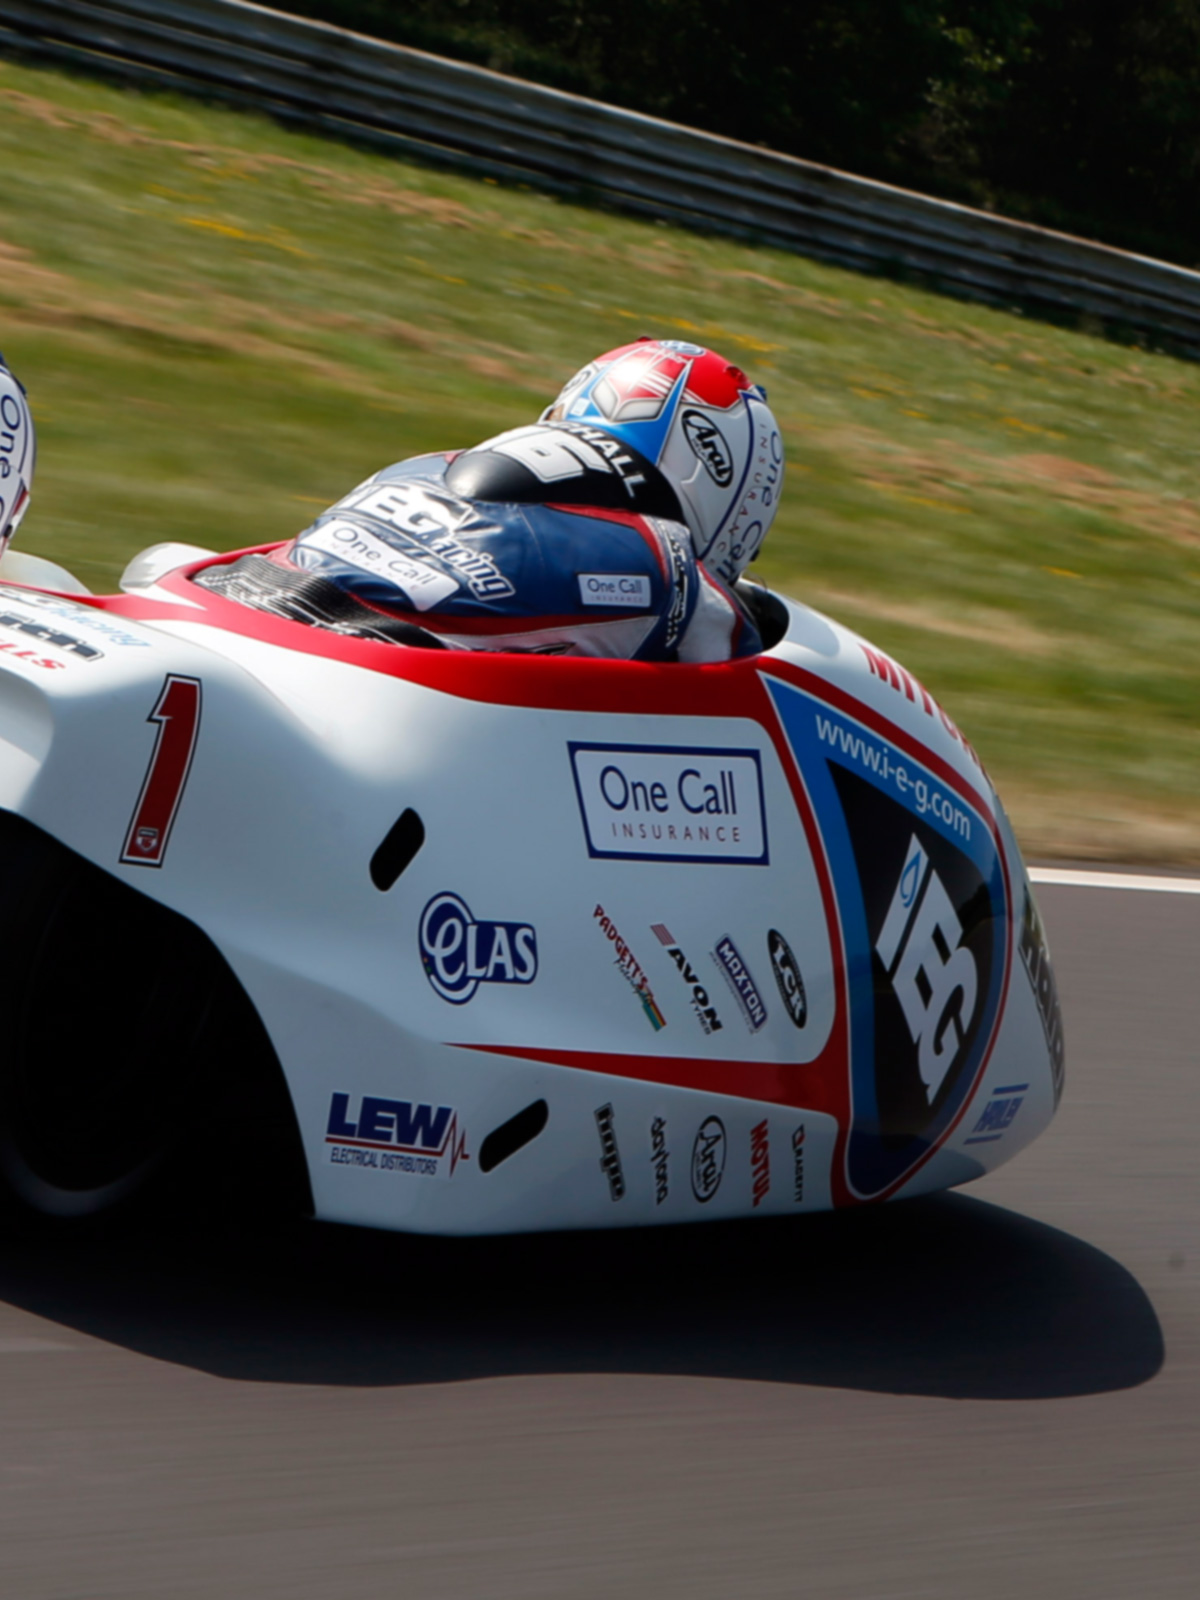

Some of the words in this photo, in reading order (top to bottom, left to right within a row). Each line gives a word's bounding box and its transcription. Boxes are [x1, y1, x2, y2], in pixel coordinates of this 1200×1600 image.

[683, 411, 732, 480] Arai
[762, 431, 782, 507] One
[333, 527, 381, 561] One
[387, 560, 438, 586] Call
[587, 578, 615, 593] One
[618, 579, 642, 594] Call
[119, 673, 202, 868] 1
[600, 765, 669, 813] One
[678, 768, 737, 815] Call
[816, 714, 971, 840] www.i-e-g.com
[612, 822, 741, 842] INSURANCE
[593, 904, 648, 990] PADGETT'S
[667, 948, 723, 1031] AVON
[720, 942, 764, 1023] MAXTON
[327, 1092, 452, 1149] LEW
[331, 1147, 378, 1168] ELECTRICAL
[381, 1153, 438, 1175] DISTRIBUTORS
[698, 1130, 722, 1192] Arai
[750, 1118, 770, 1208] MOTUL
